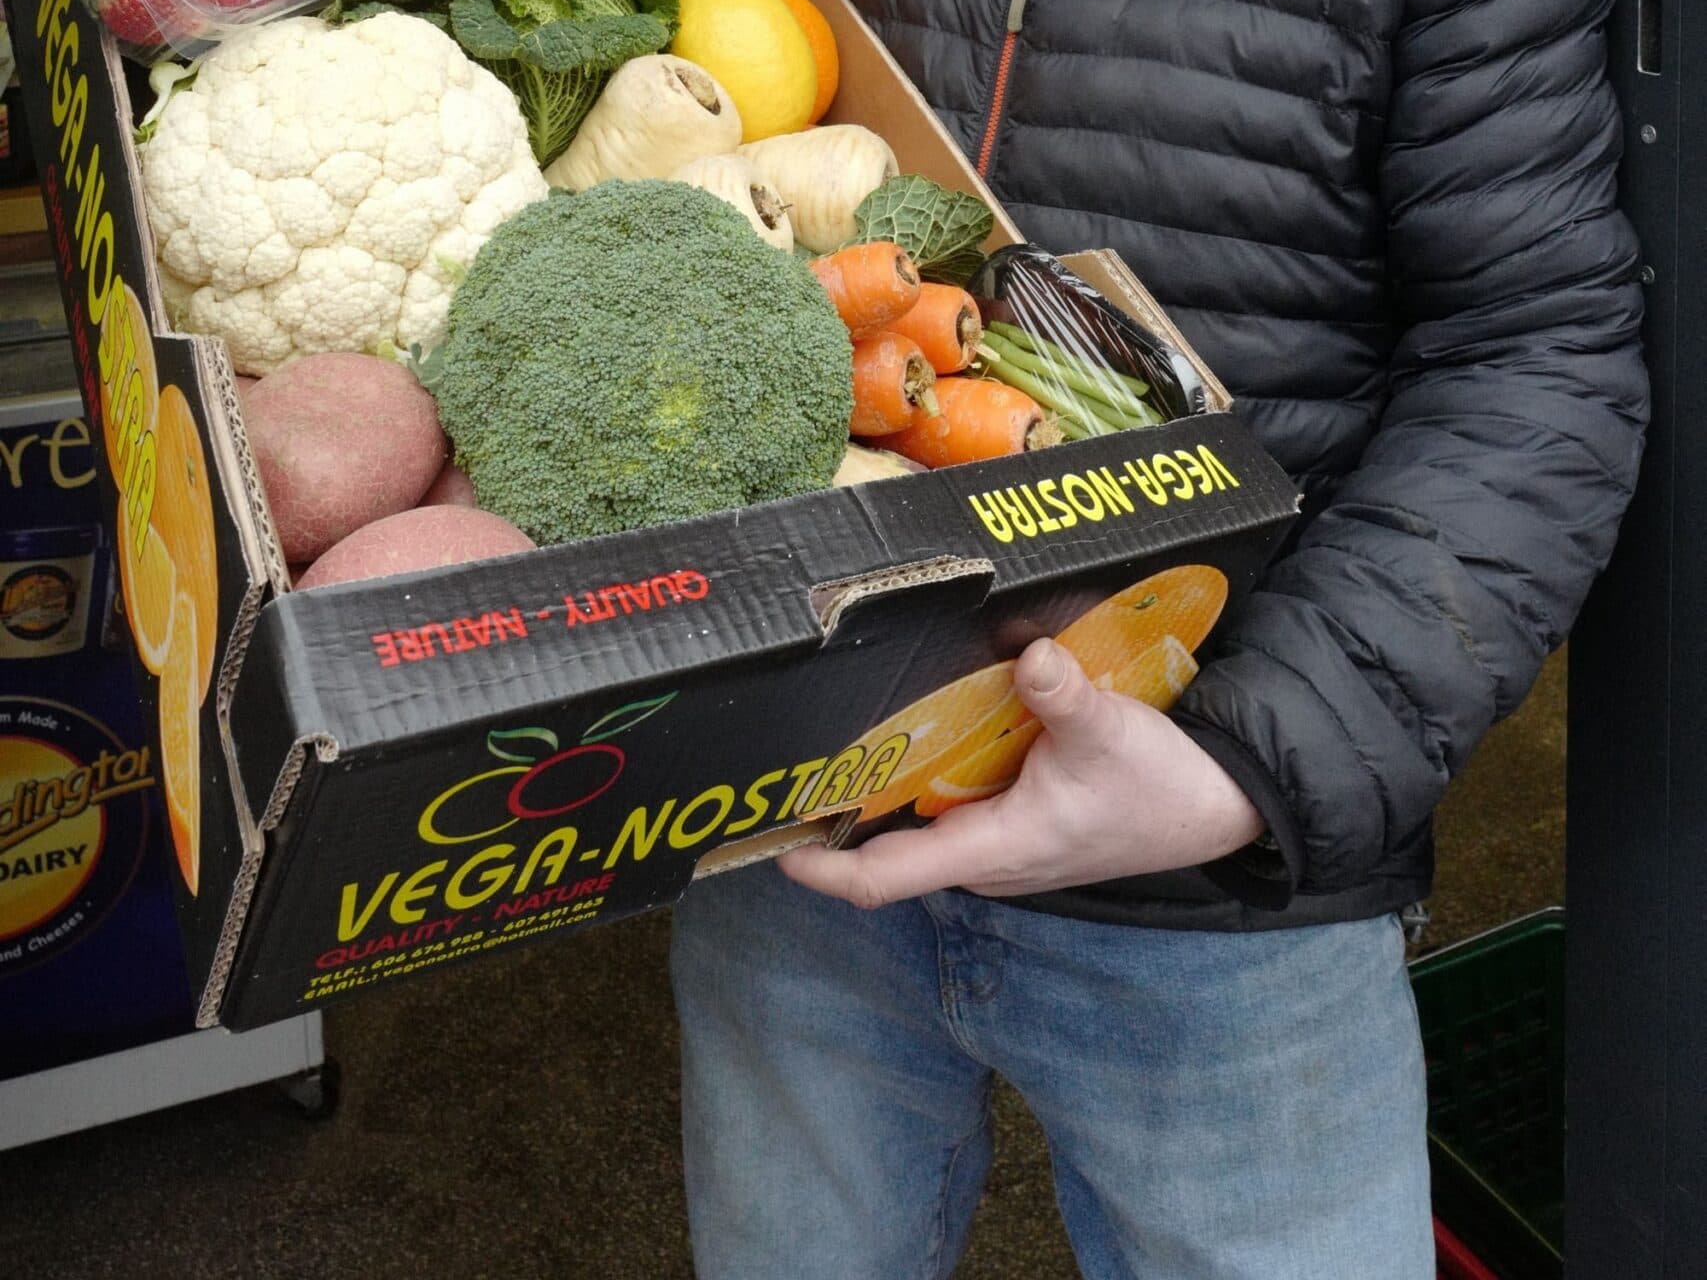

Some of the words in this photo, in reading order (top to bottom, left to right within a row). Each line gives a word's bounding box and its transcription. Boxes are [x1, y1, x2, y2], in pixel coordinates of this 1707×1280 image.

[967, 443, 1241, 544] VEGA-NOSTRA
[562, 569, 710, 629] QUALITY
[370, 606, 530, 668] NATURE
[18, 710, 59, 730] Made
[336, 732, 911, 942] VEGA-NOSTRA
[28, 912, 84, 951] Cheeses
[315, 913, 464, 969] QUALITY
[494, 872, 617, 920] NATURE
